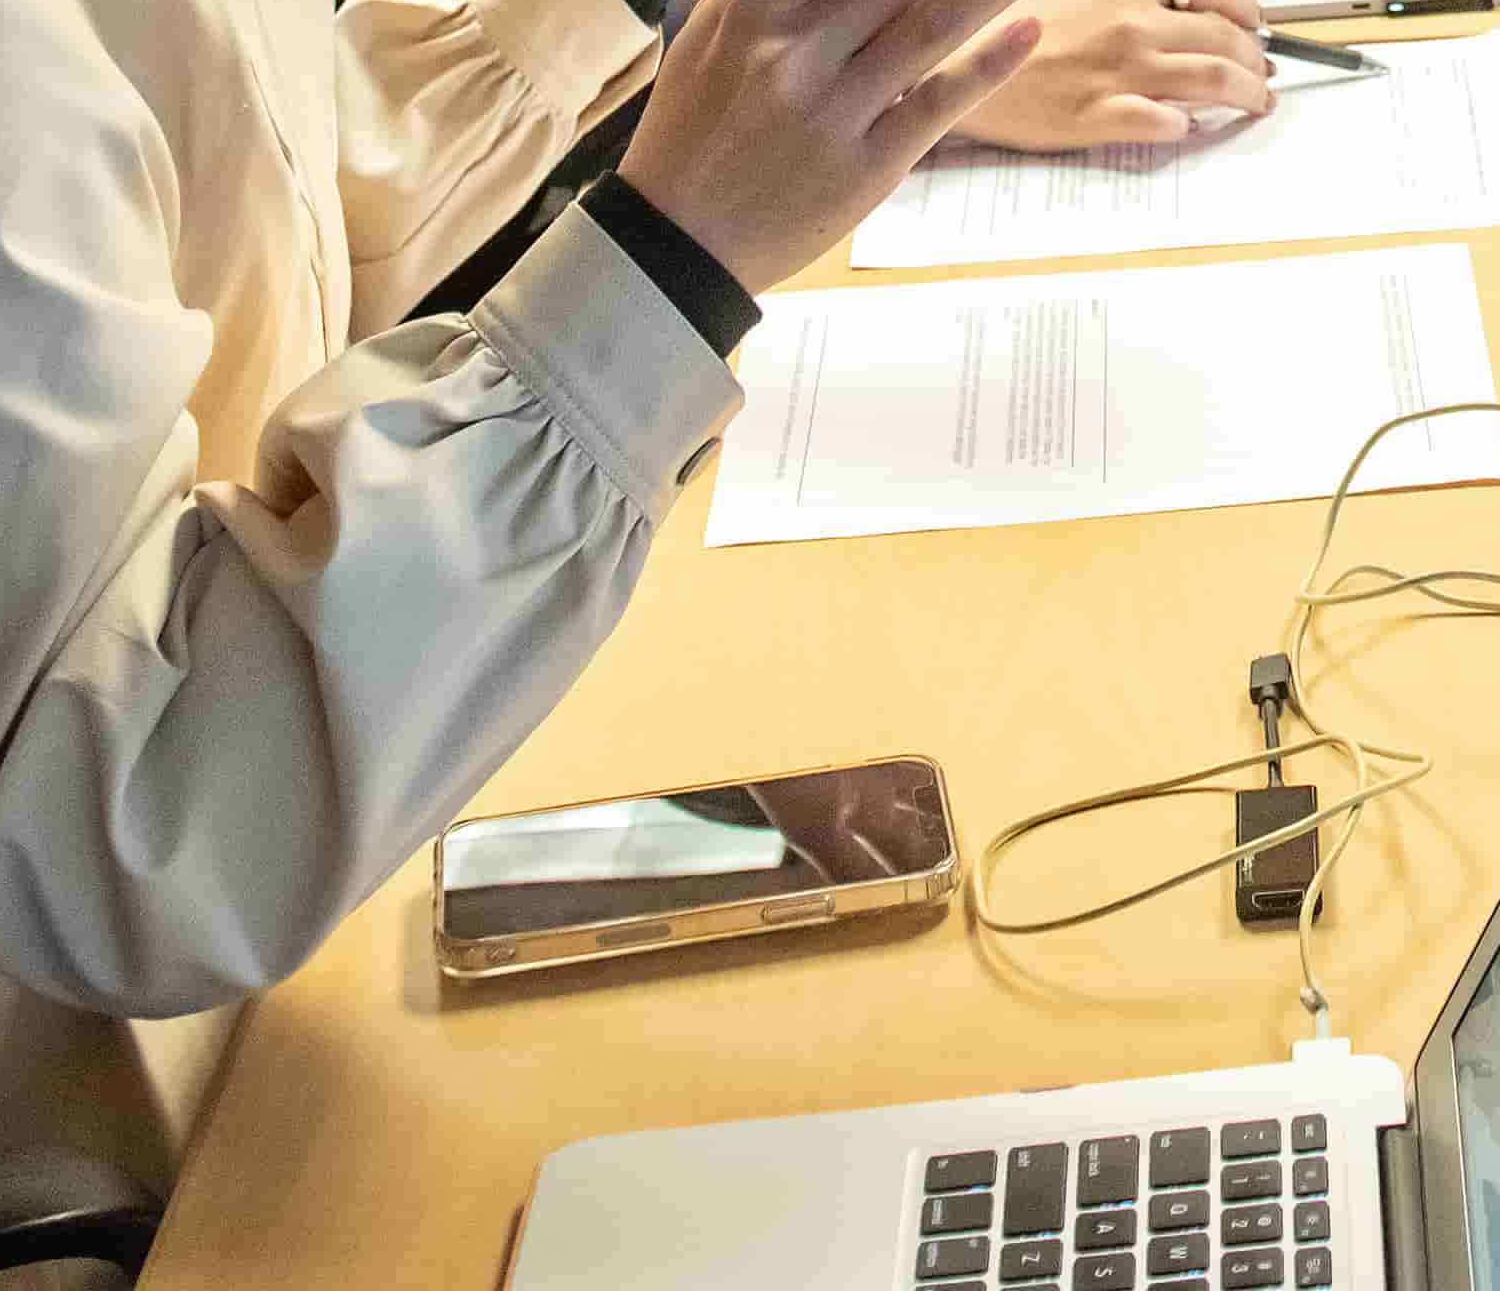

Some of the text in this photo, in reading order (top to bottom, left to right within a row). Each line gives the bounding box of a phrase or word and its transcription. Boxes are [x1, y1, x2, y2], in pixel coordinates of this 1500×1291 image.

[1169, 1203, 1189, 1216] Q
[1094, 1221, 1116, 1235] A
[1021, 1250, 1041, 1267] Z
[1169, 1246, 1189, 1259] W
[1094, 1265, 1115, 1278] S
